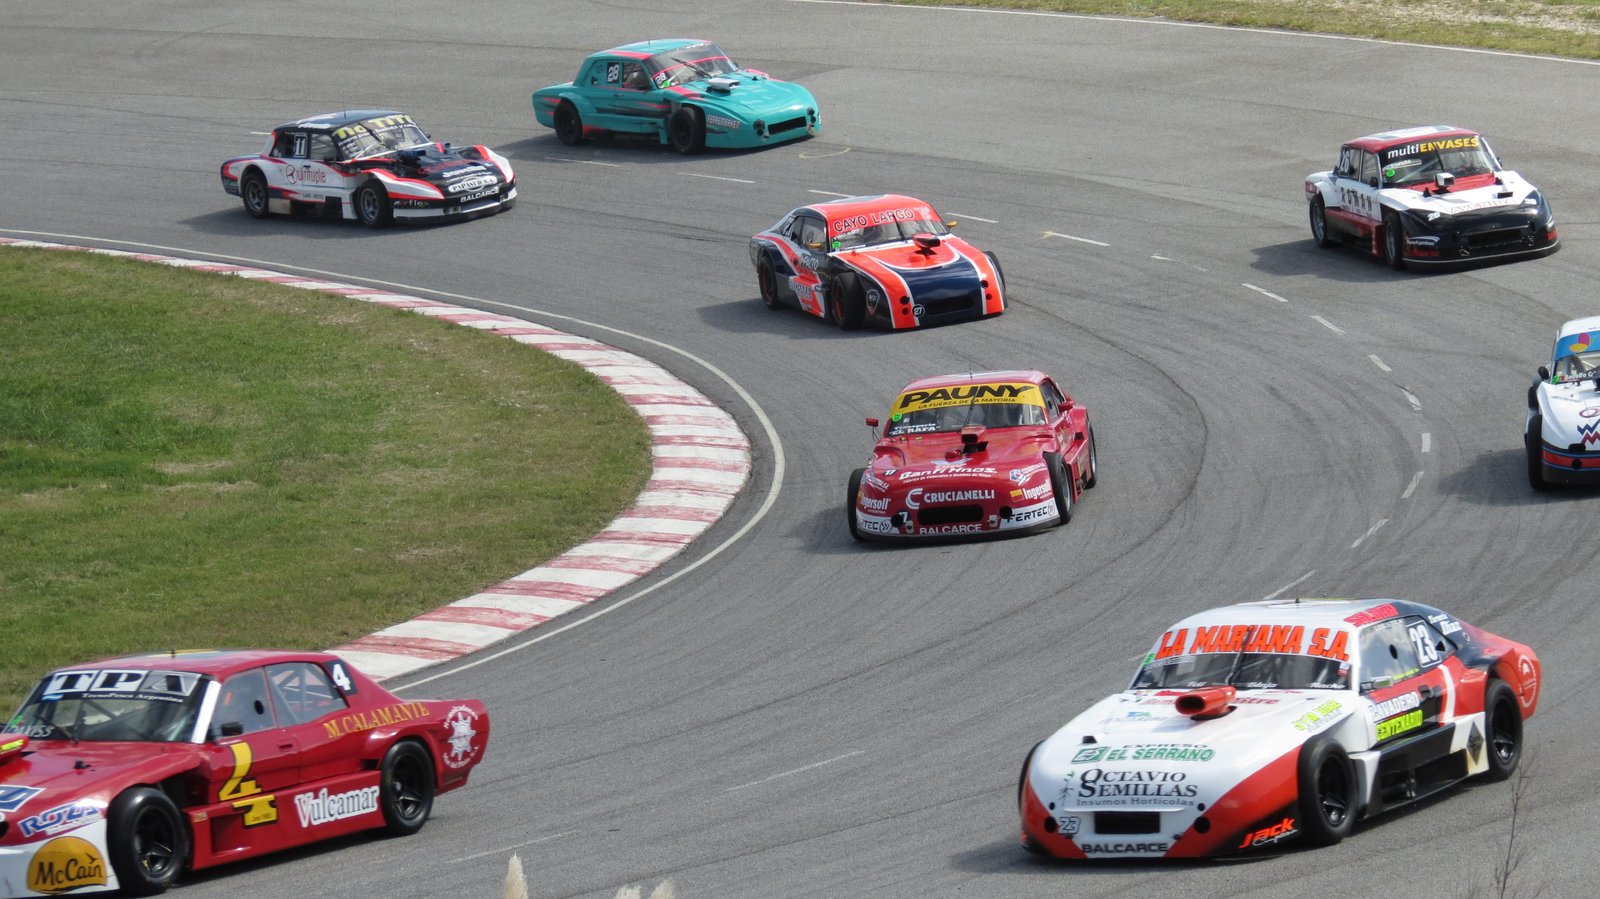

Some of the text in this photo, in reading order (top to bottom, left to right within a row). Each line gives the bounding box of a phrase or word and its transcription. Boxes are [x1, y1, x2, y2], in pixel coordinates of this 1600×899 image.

[460, 186, 500, 203] BALCARCE
[833, 208, 914, 232] CAYO LARGO
[899, 384, 1036, 409] PAUNY
[929, 400, 957, 408] FUERZA
[923, 489, 995, 503] CRUCIANELLI
[1007, 506, 1048, 523] FERTEC
[919, 523, 983, 536] BALCARCE
[1155, 624, 1350, 661] LA MARIANA S.A.
[1409, 625, 1439, 664] 23
[51, 672, 186, 693] TPA
[332, 663, 351, 691] 4
[136, 693, 184, 703] Argentina
[343, 702, 431, 734] CALAMANTE
[1106, 748, 1216, 762] EL SERRANO
[218, 741, 278, 827] 4
[1080, 768, 1186, 784] OCTAVIO
[1078, 781, 1198, 798] SEMILLAS
[295, 788, 380, 828] Vulcamar
[1076, 798, 1127, 806] Insumos
[1059, 816, 1081, 834] 23
[1082, 842, 1168, 853] BALCARCE
[34, 858, 103, 887] McCain
